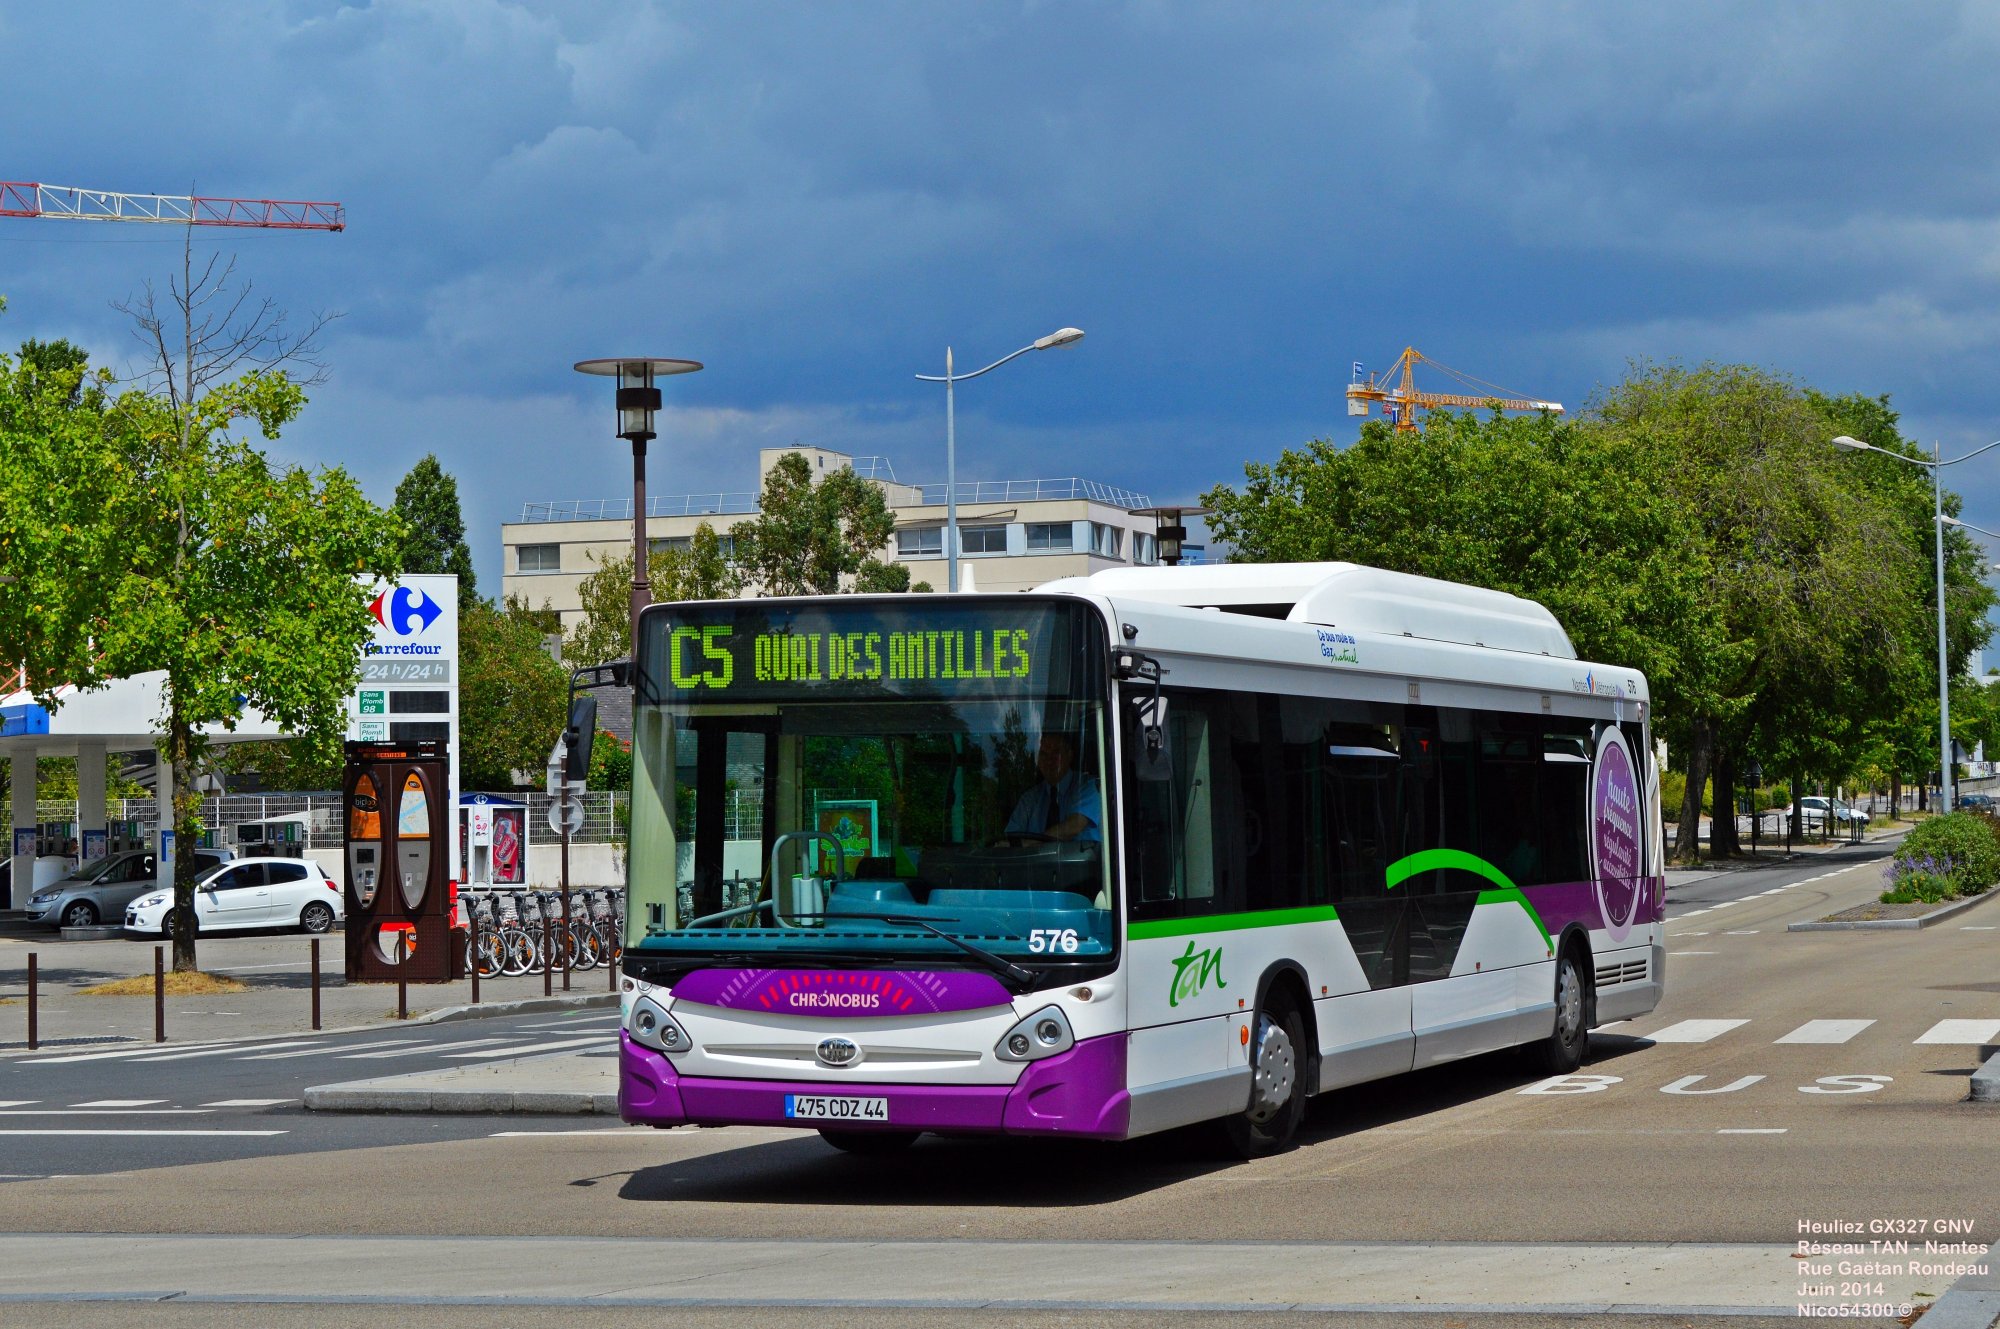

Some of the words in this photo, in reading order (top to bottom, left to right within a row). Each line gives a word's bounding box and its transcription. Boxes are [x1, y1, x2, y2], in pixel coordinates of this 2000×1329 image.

[1324, 631, 1335, 643] bus
[671, 625, 734, 689] C5
[755, 633, 822, 681] QUAI
[829, 632, 882, 680] DES
[889, 629, 1030, 680] ANTILLES
[1321, 643, 1334, 657] Gaz
[363, 705, 376, 714] 98
[1608, 769, 1631, 814] haute
[1603, 796, 1633, 840] fréquence
[1028, 928, 1078, 953] 576
[1169, 940, 1227, 1007] tan
[1515, 1074, 1894, 1095] BUS
[796, 1098, 826, 1116] 475
[829, 1098, 860, 1117] CDZ
[864, 1100, 884, 1118] 44
